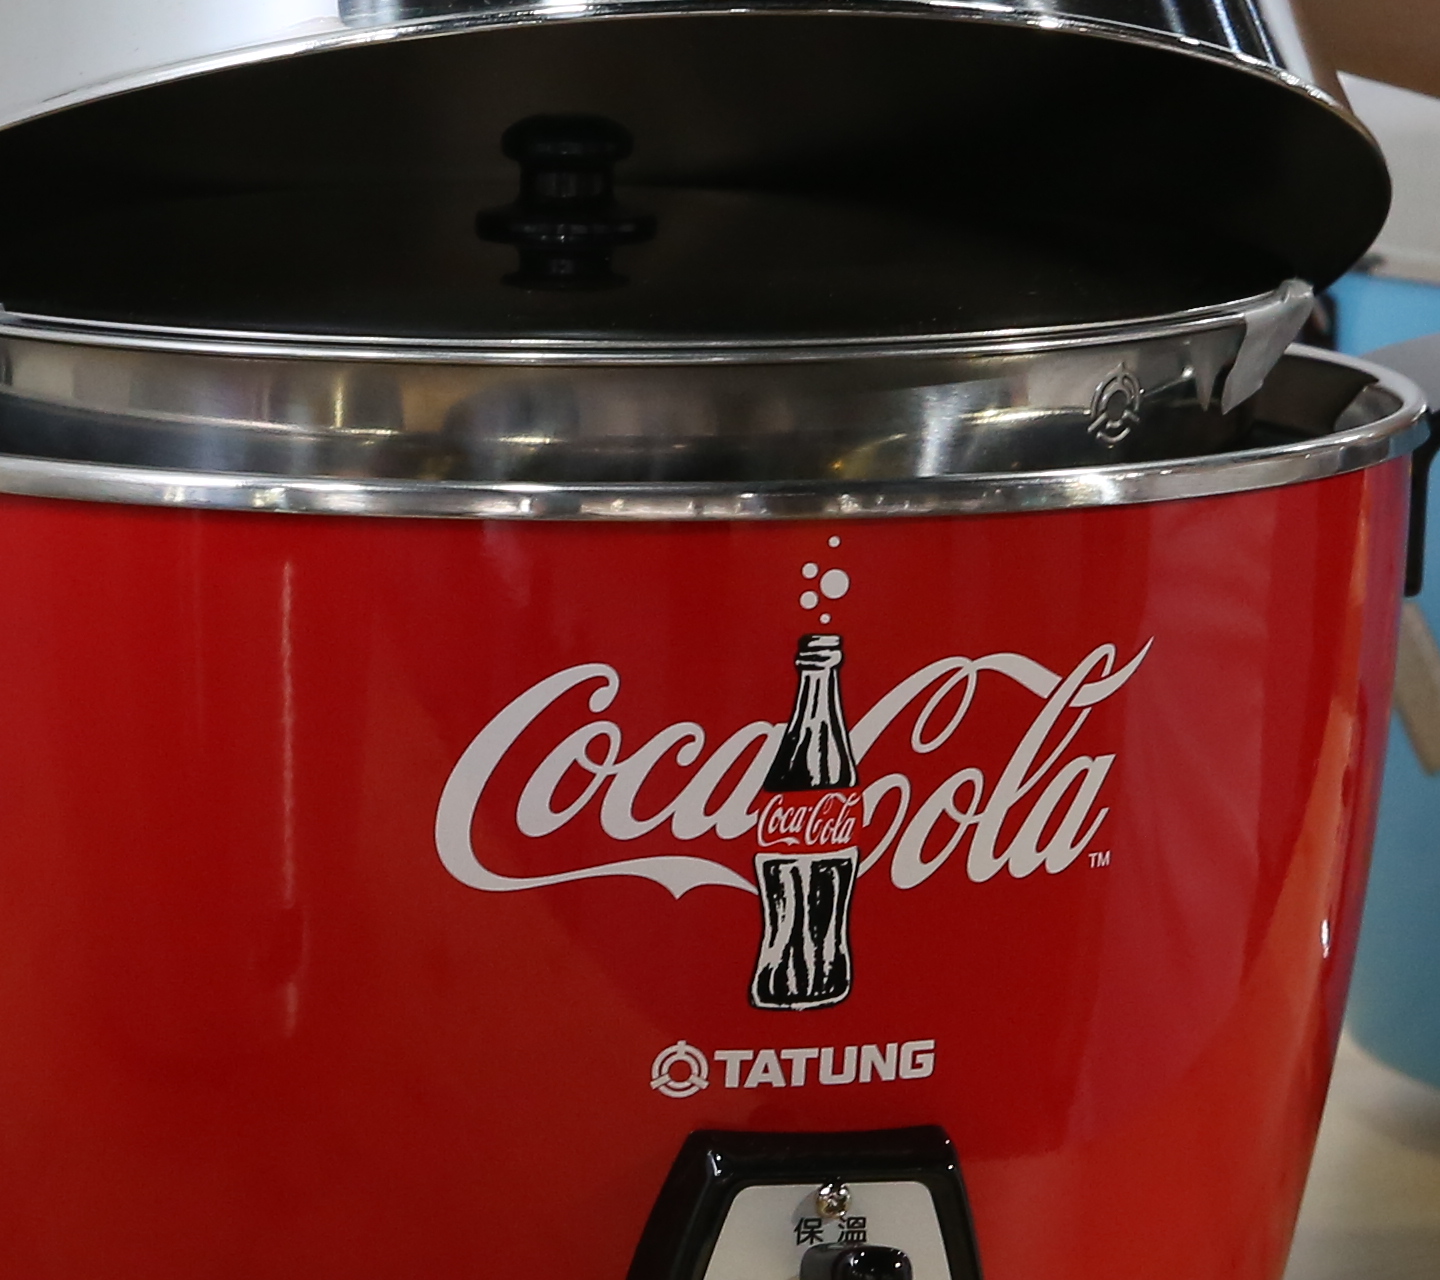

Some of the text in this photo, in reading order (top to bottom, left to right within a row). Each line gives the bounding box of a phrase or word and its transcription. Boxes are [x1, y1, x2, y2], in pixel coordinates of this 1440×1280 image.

[1088, 850, 1111, 869] TM
[715, 1039, 936, 1089] TATUNG
[793, 1216, 868, 1246] 保溫
